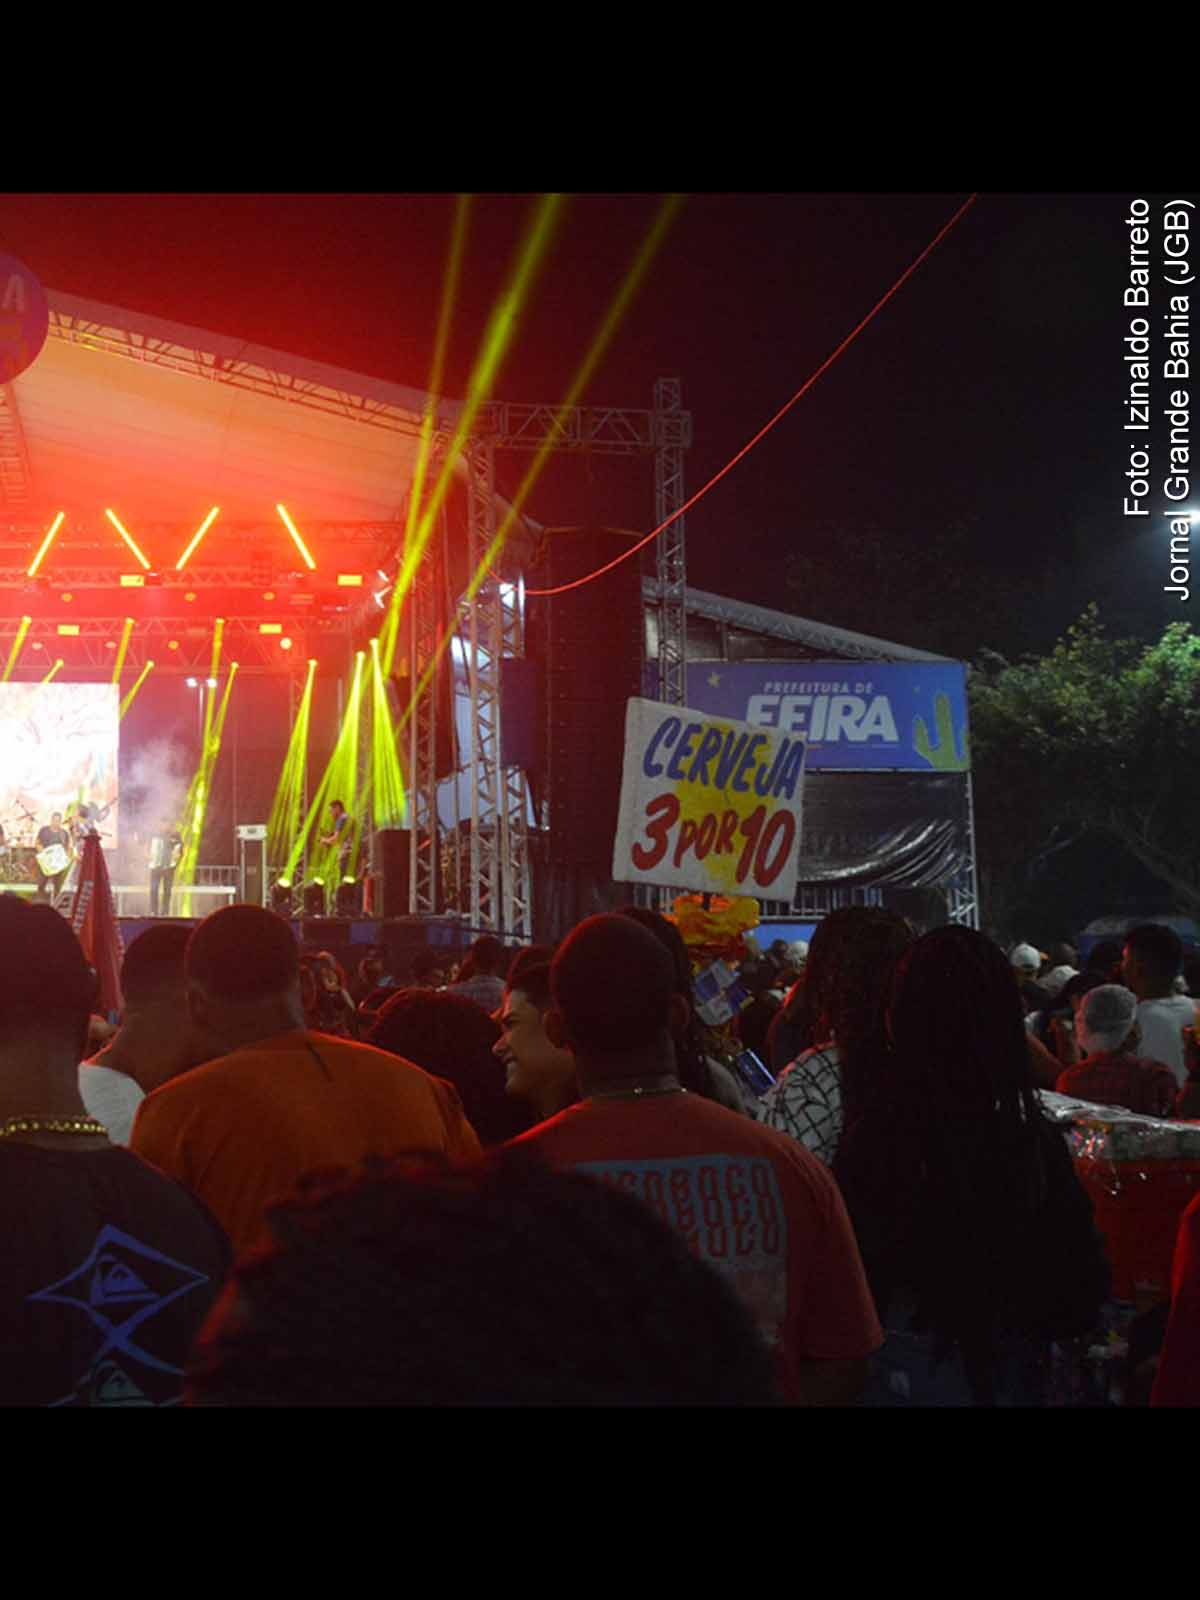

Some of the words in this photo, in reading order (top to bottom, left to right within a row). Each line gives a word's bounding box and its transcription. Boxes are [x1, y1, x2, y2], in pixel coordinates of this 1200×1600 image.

[763, 682, 849, 694] PREFEITURA
[855, 682, 873, 694] DE
[643, 716, 805, 800] CERVEJA
[631, 793, 680, 871] 3
[673, 809, 739, 868] POR
[735, 804, 796, 888] 10
